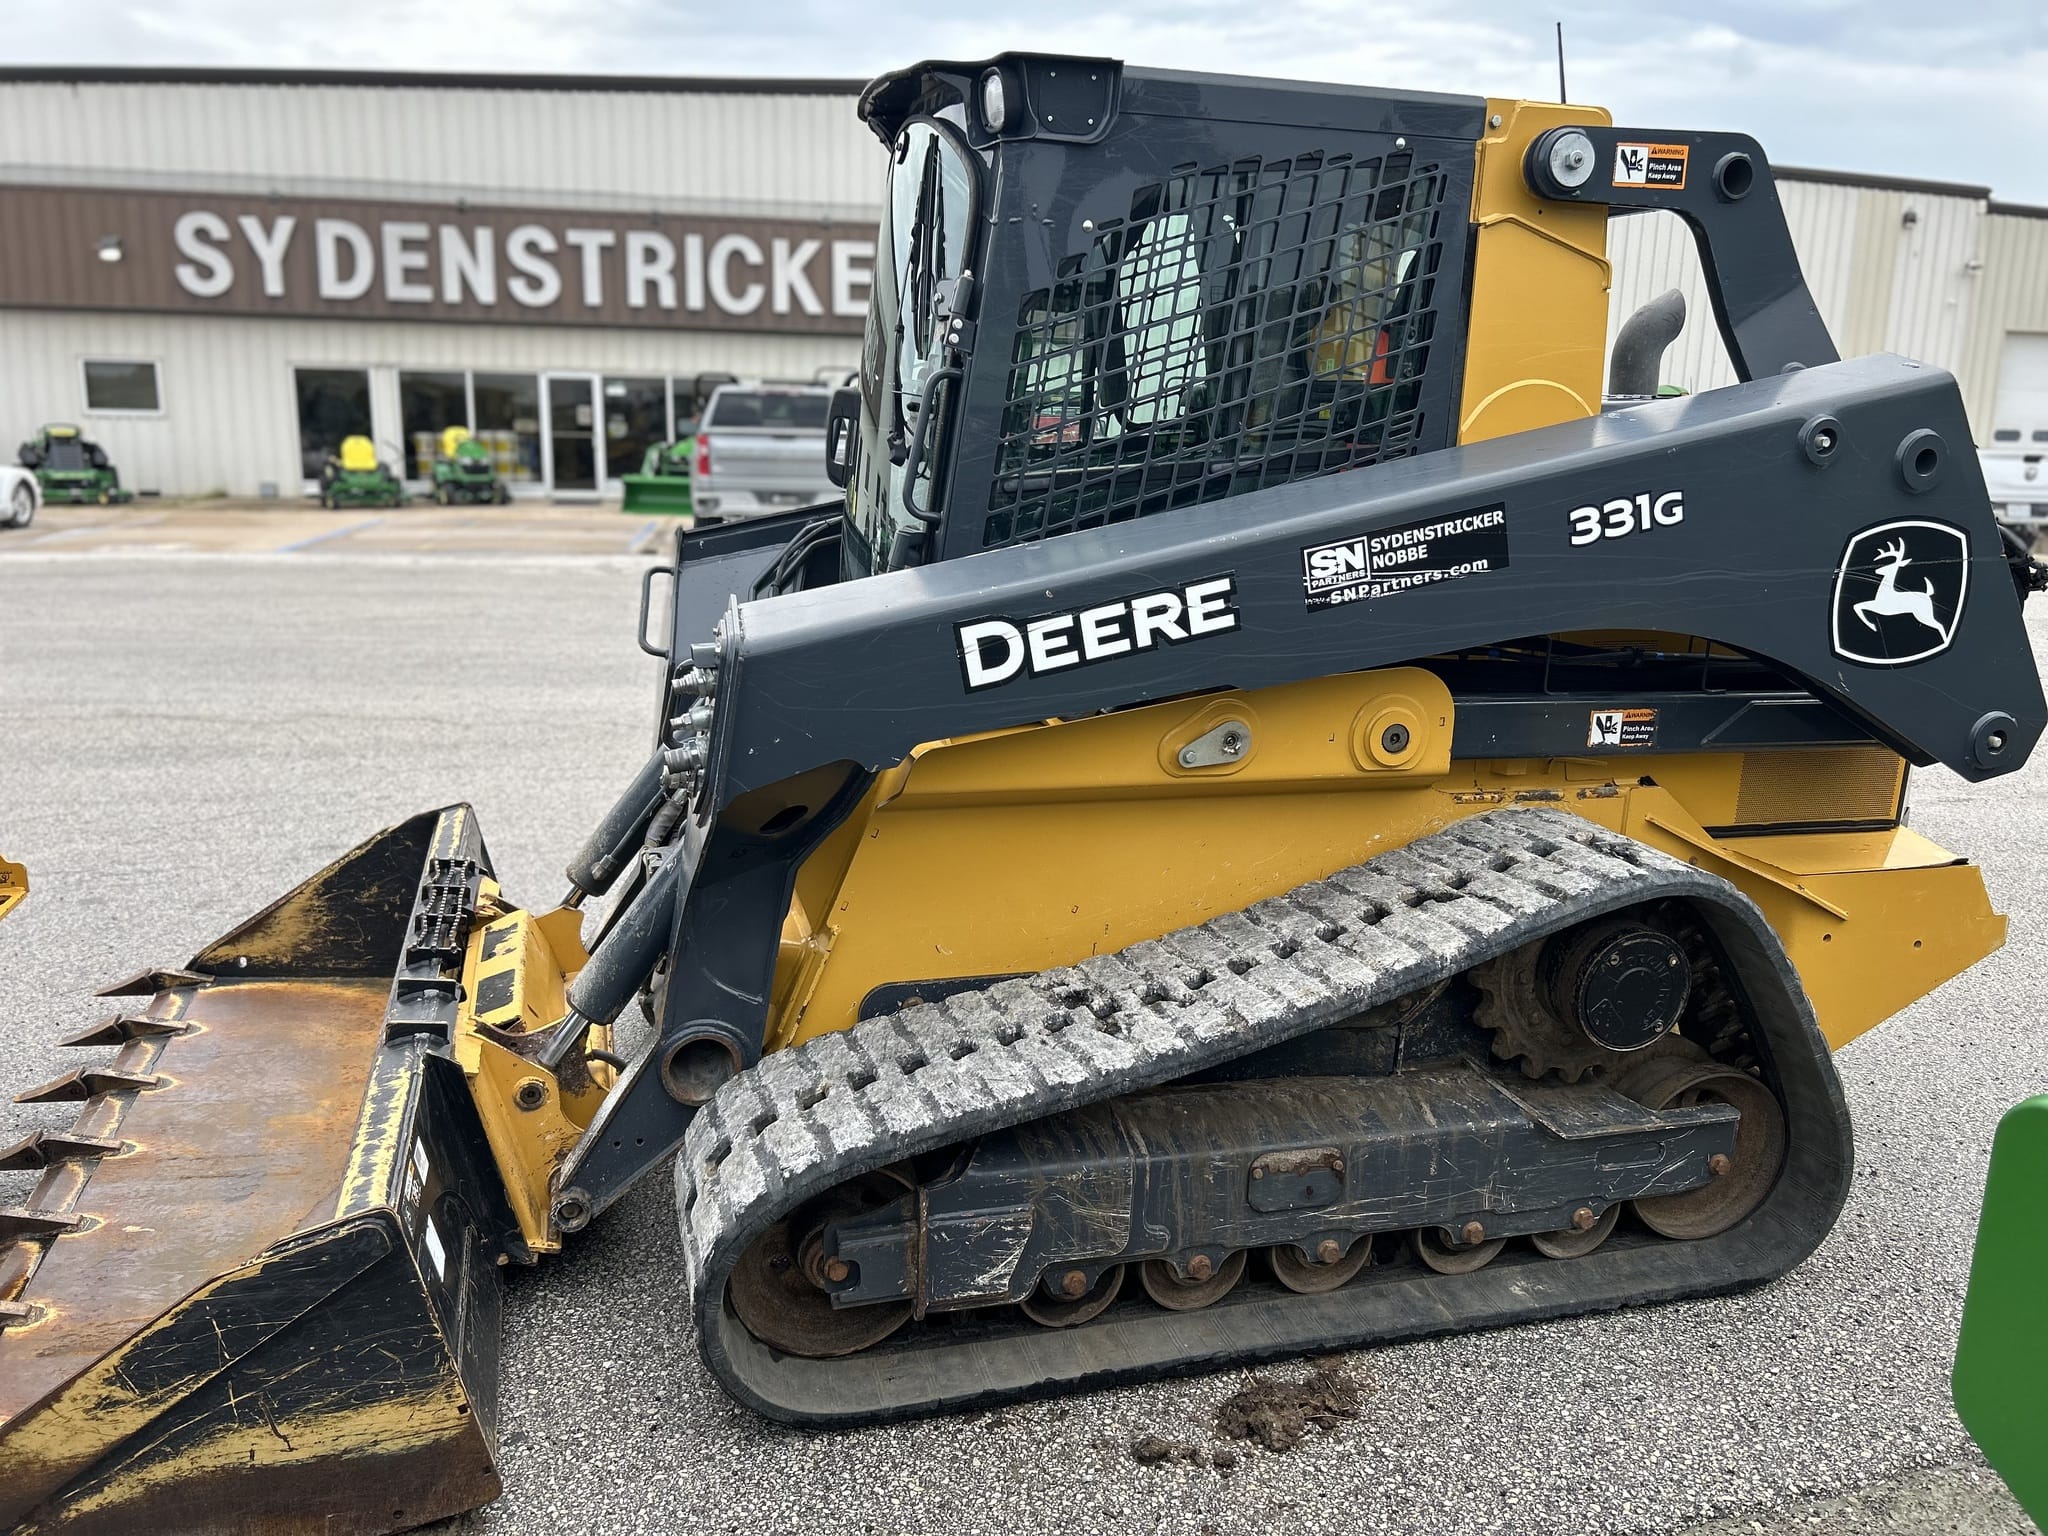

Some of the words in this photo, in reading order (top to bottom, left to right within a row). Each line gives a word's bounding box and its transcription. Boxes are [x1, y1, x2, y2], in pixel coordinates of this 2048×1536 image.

[1649, 163, 1667, 171] Pinch
[1667, 163, 1682, 172] Area
[173, 210, 876, 317] SYDENSTRICKE
[1370, 510, 1505, 553] SYDENSTRICKER
[1568, 491, 1684, 546] 331G
[1372, 544, 1429, 570] NOBBE
[1311, 569, 1366, 588] PARTNERS
[959, 577, 1237, 688] DEERE
[1631, 711, 1656, 719] WARNIN
[1622, 725, 1640, 733] Pinch
